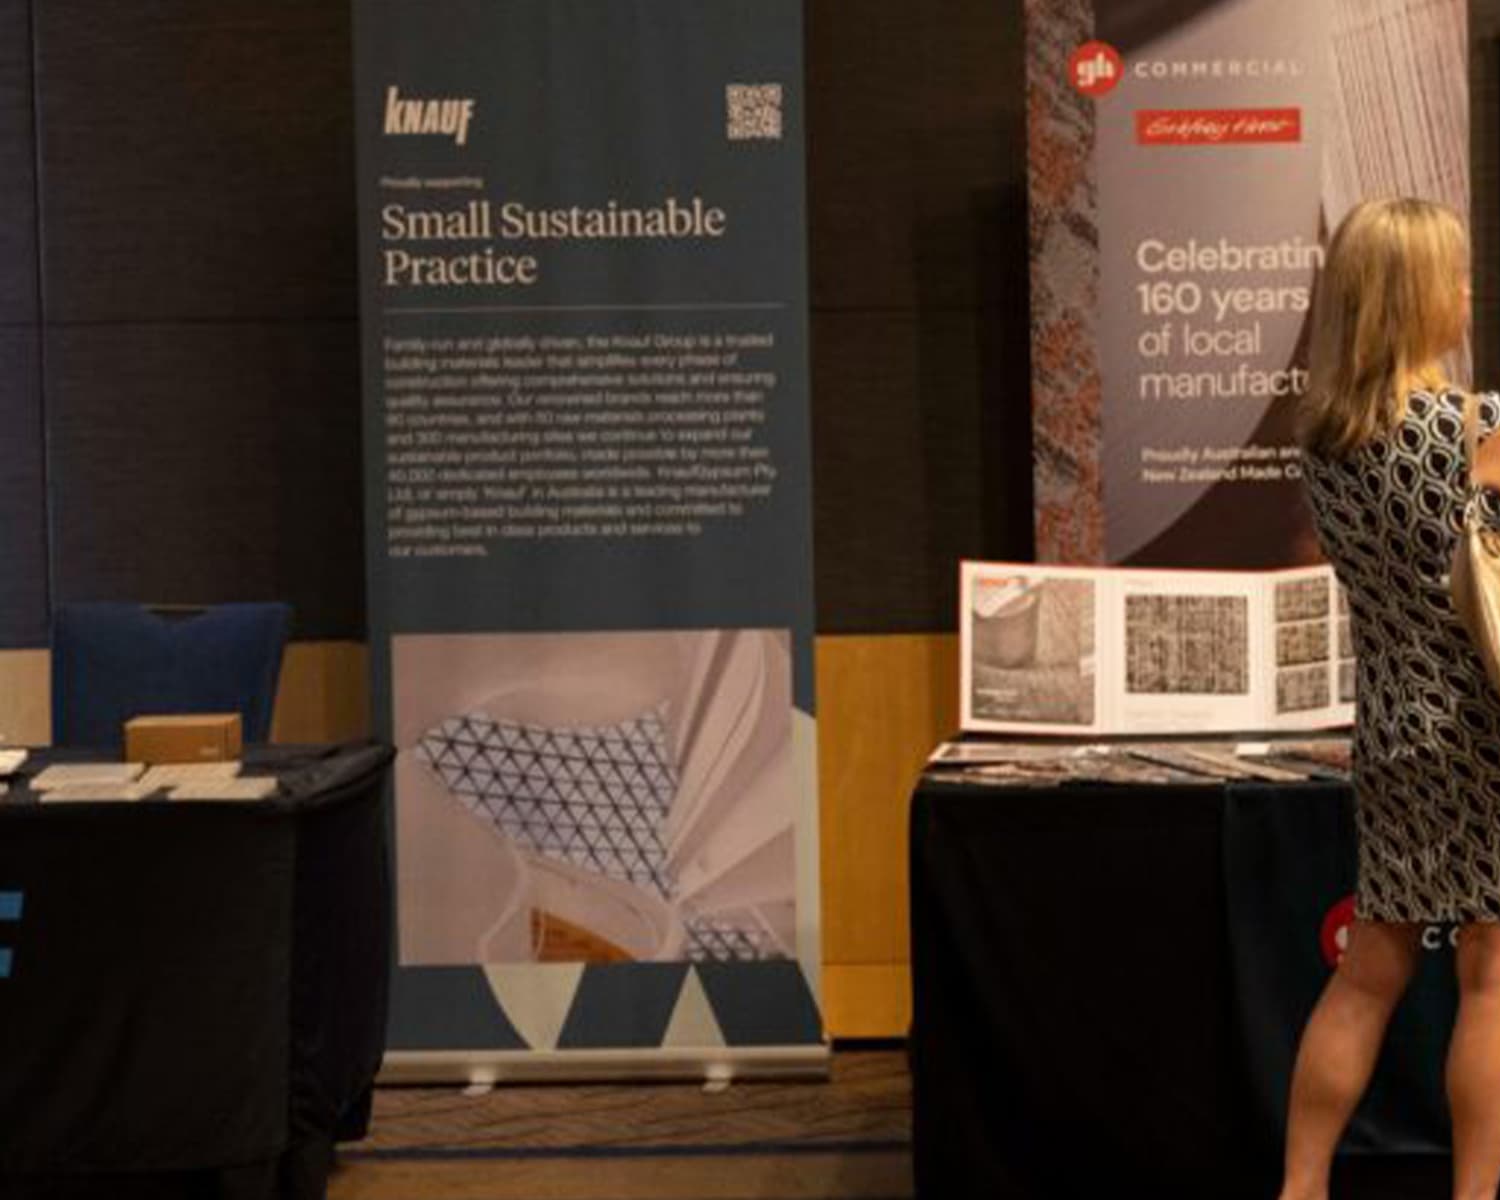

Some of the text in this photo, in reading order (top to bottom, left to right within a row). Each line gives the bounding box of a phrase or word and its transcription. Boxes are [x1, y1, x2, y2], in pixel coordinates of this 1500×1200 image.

[1134, 59, 1302, 79] COMMERCIAL
[382, 196, 727, 240] Small Sustainable
[384, 248, 539, 286] Practice
[1137, 237, 1326, 273] Celebratin
[1138, 281, 1310, 322] 160 years
[1138, 321, 1262, 357] of local
[1140, 364, 1309, 399] manufact
[1141, 447, 1197, 464] Proudly
[1203, 445, 1277, 462] Australian
[1143, 467, 1176, 482] New
[1179, 465, 1237, 482] Zealand
[1241, 464, 1282, 480] Made
